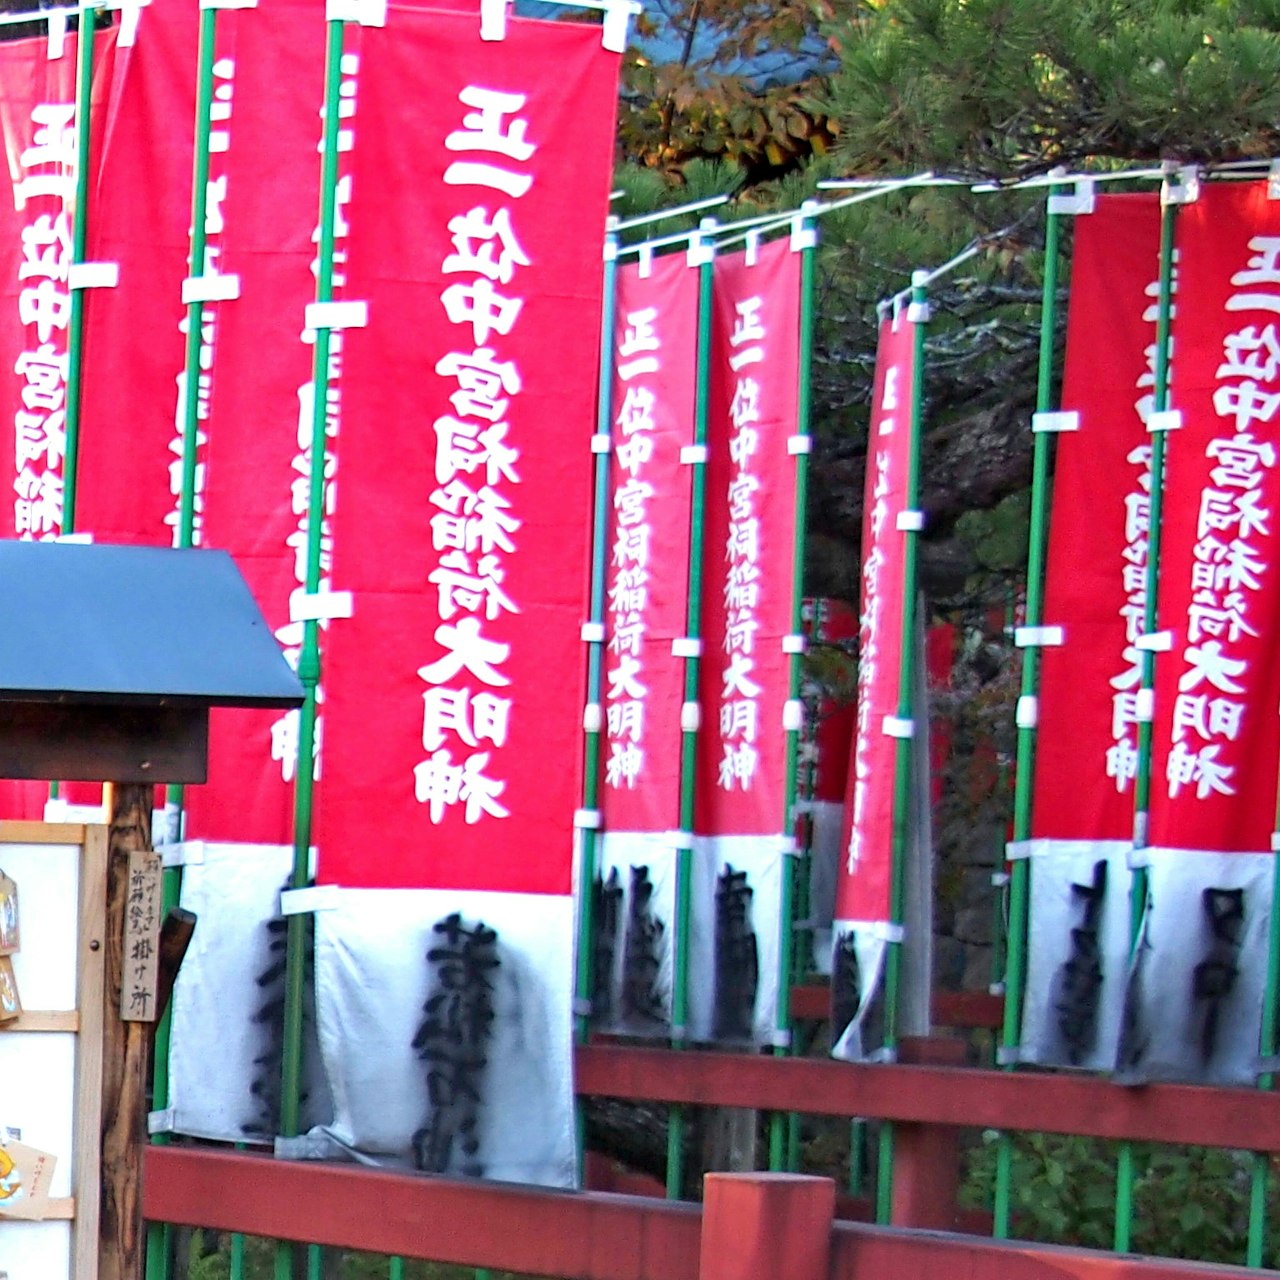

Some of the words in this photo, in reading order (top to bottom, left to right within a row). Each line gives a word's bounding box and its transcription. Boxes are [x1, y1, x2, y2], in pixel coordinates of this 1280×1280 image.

[604, 306, 661, 792] 正一位中宮祠稲荷大明神
[717, 296, 767, 792] 正一位中宮祠稲荷大明神
